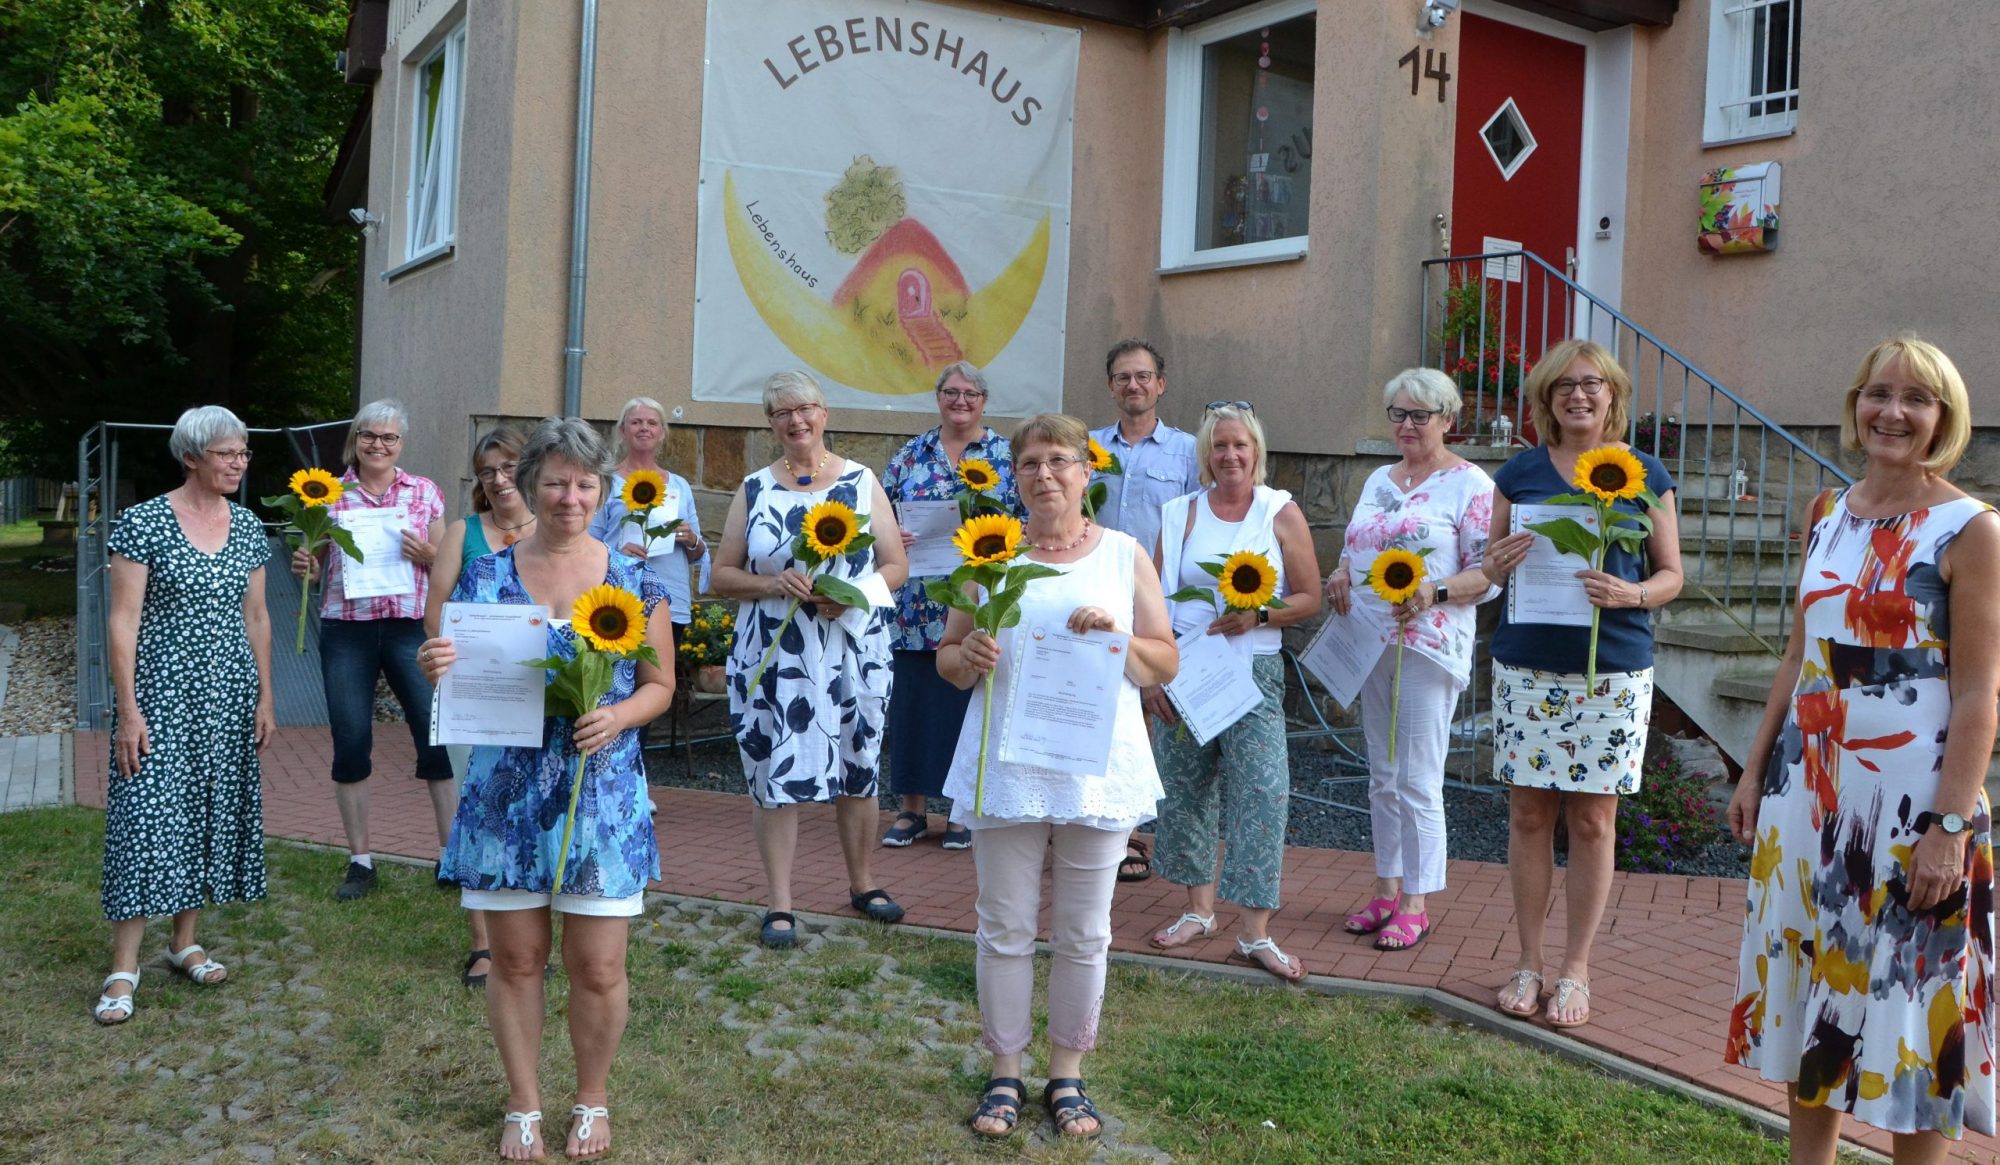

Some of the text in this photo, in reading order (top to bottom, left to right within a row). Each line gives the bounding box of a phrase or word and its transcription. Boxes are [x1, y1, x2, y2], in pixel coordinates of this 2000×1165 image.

[763, 17, 1042, 126] LEBENSHAUS
[1398, 45, 1451, 103] 14
[746, 200, 818, 289] Lebenshaus
